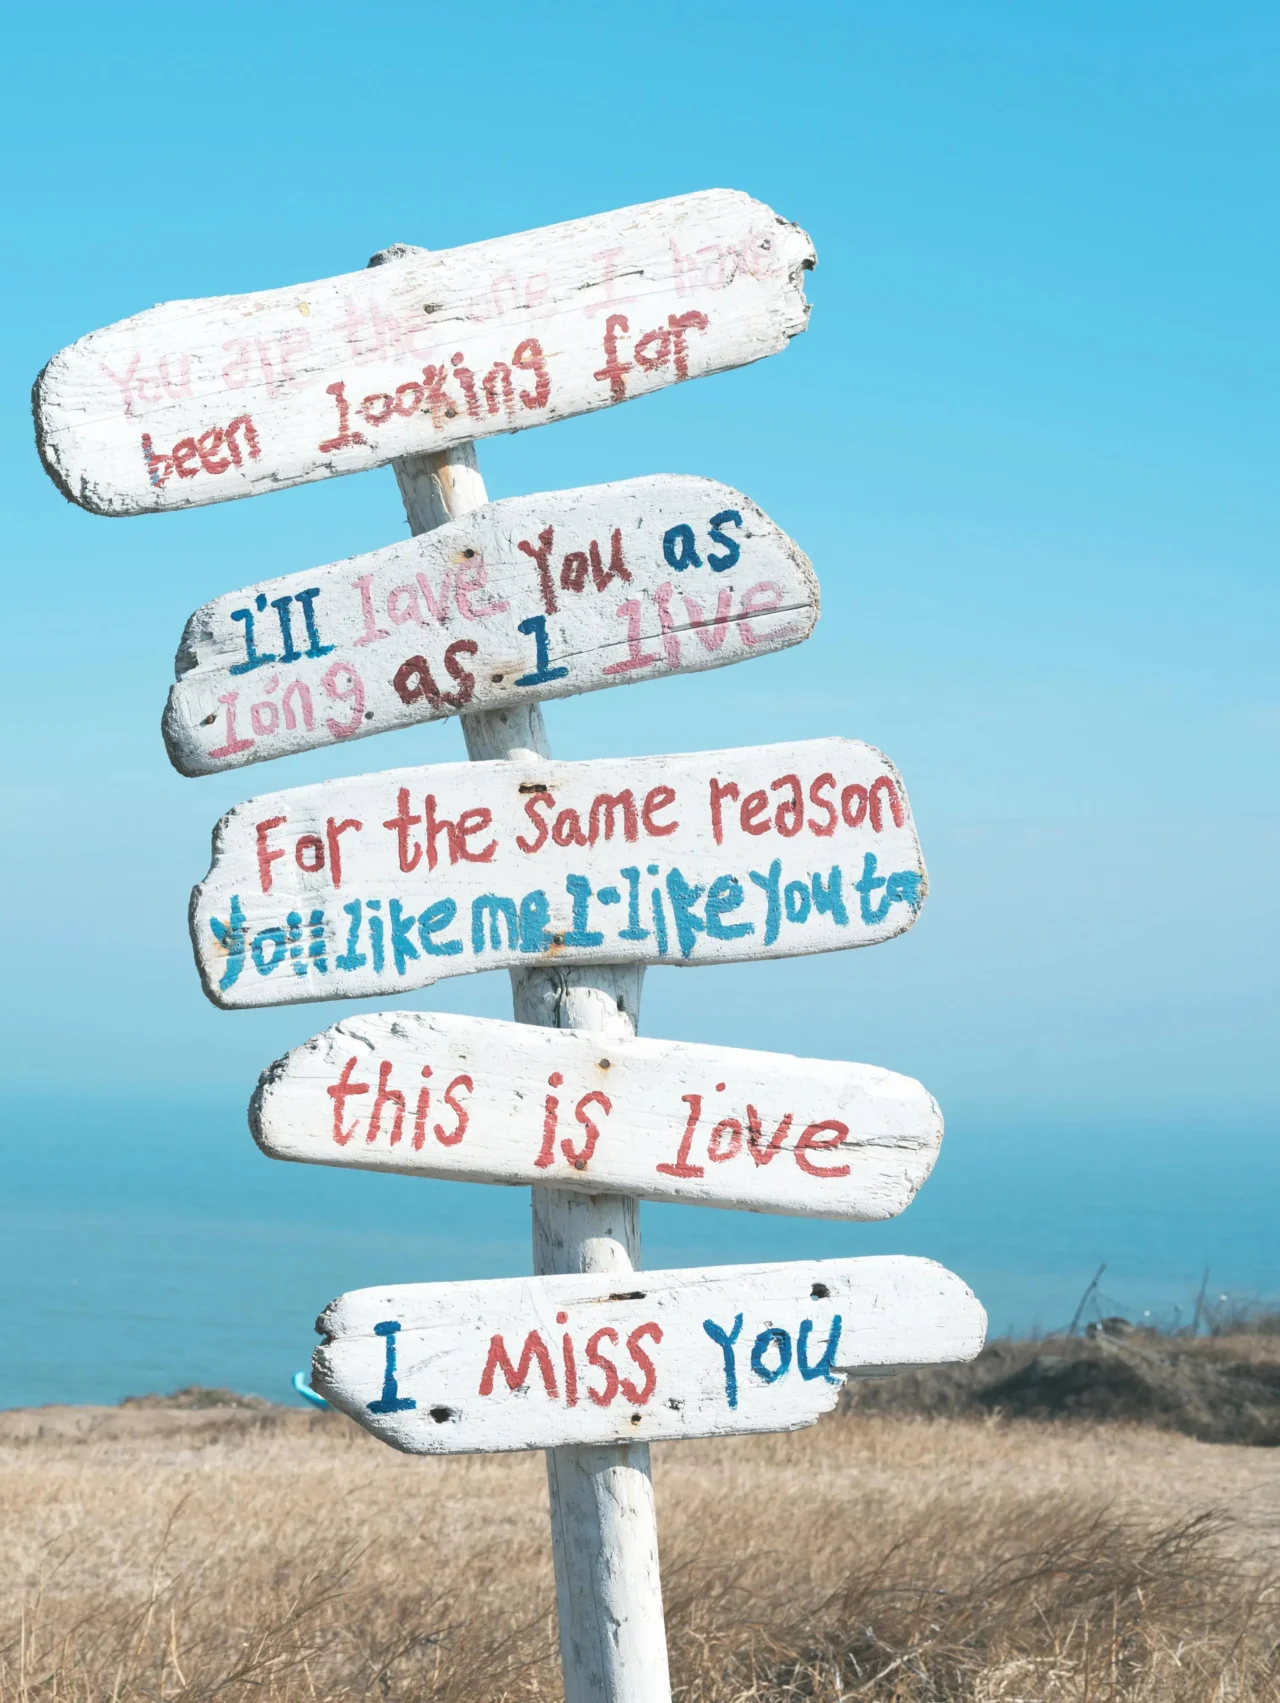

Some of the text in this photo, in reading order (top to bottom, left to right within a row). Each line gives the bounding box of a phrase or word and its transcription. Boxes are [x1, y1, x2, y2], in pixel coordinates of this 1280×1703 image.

[583, 246, 638, 319] I
[141, 413, 261, 488] been
[319, 338, 551, 452] looking
[518, 524, 632, 614] You
[663, 509, 742, 572] as
[208, 663, 365, 758] long
[393, 639, 478, 709] as
[602, 581, 807, 675] live
[256, 815, 362, 895] For
[383, 787, 498, 873] the
[710, 772, 905, 846] reason
[336, 898, 463, 975] like
[472, 889, 552, 954] me
[327, 1055, 851, 1179] this is love
[366, 1320, 417, 1413] I
